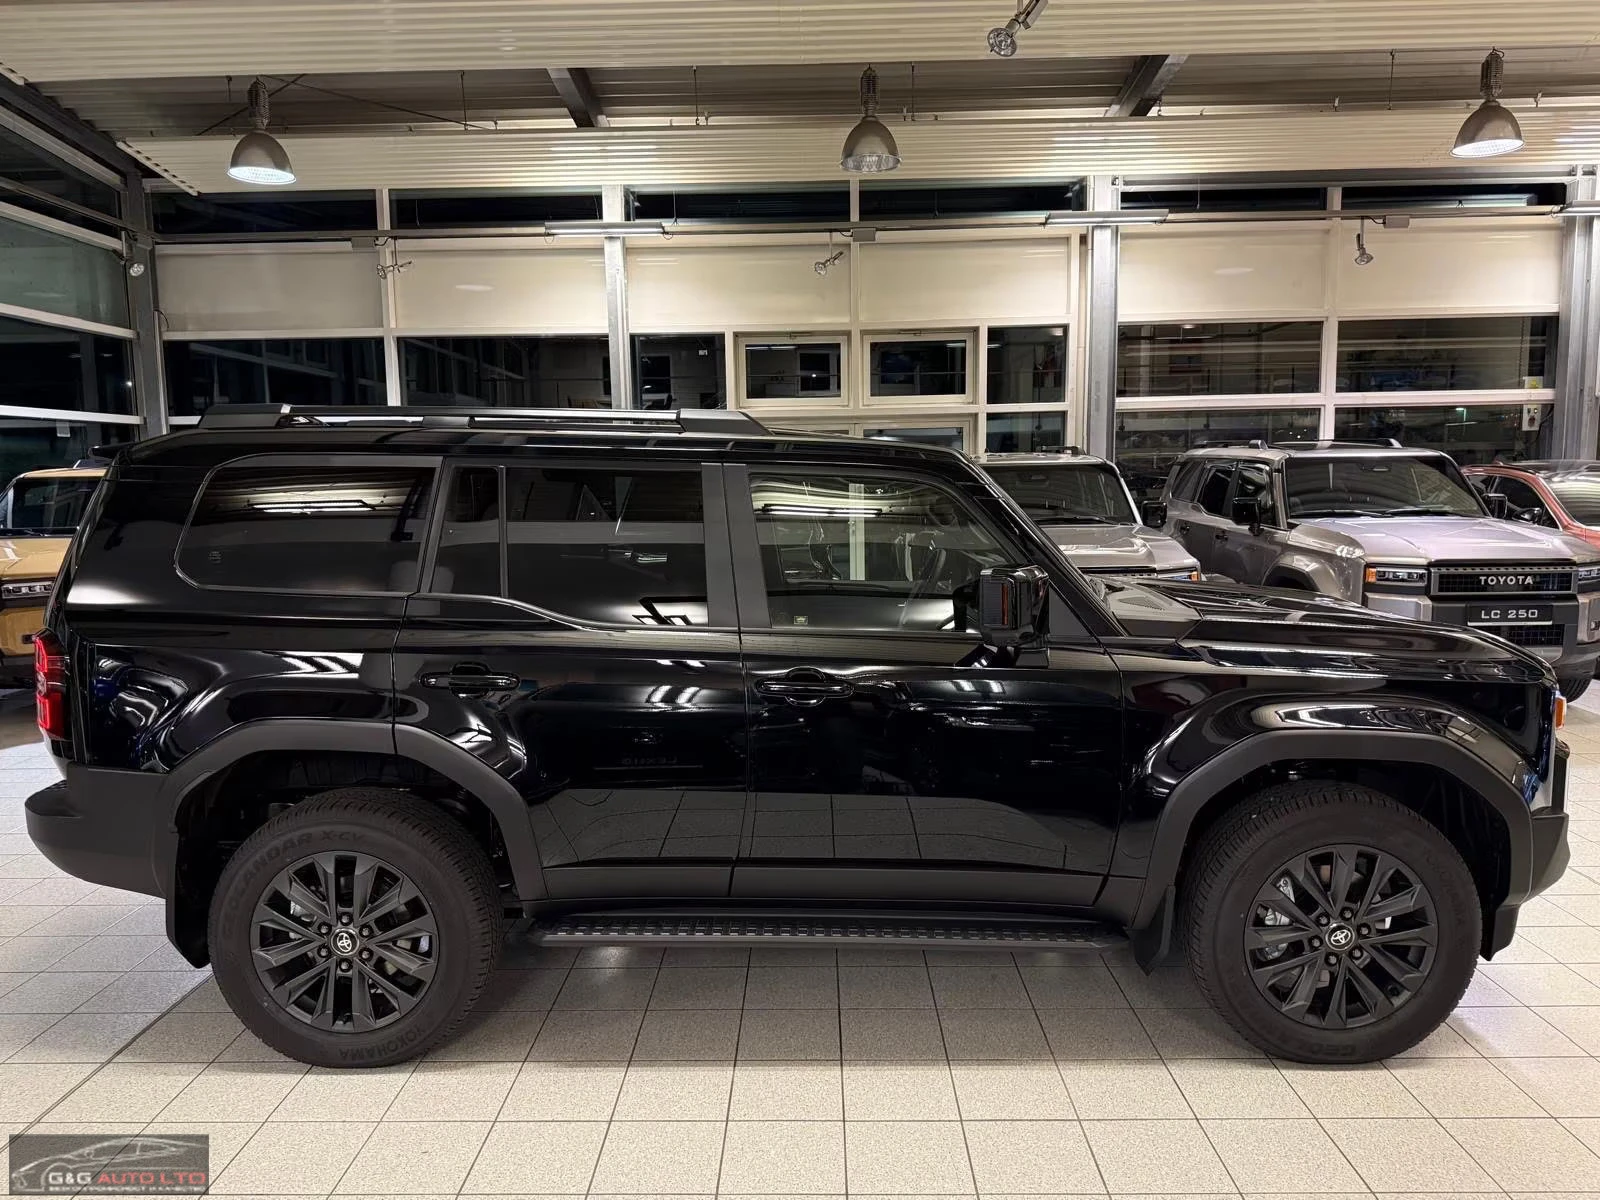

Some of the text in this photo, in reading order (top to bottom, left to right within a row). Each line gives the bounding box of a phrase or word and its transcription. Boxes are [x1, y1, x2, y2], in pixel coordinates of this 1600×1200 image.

[1480, 576, 1533, 585] TOYOTA
[1481, 609, 1538, 619] LC 250
[338, 1022, 427, 1060] YOKOHAMA
